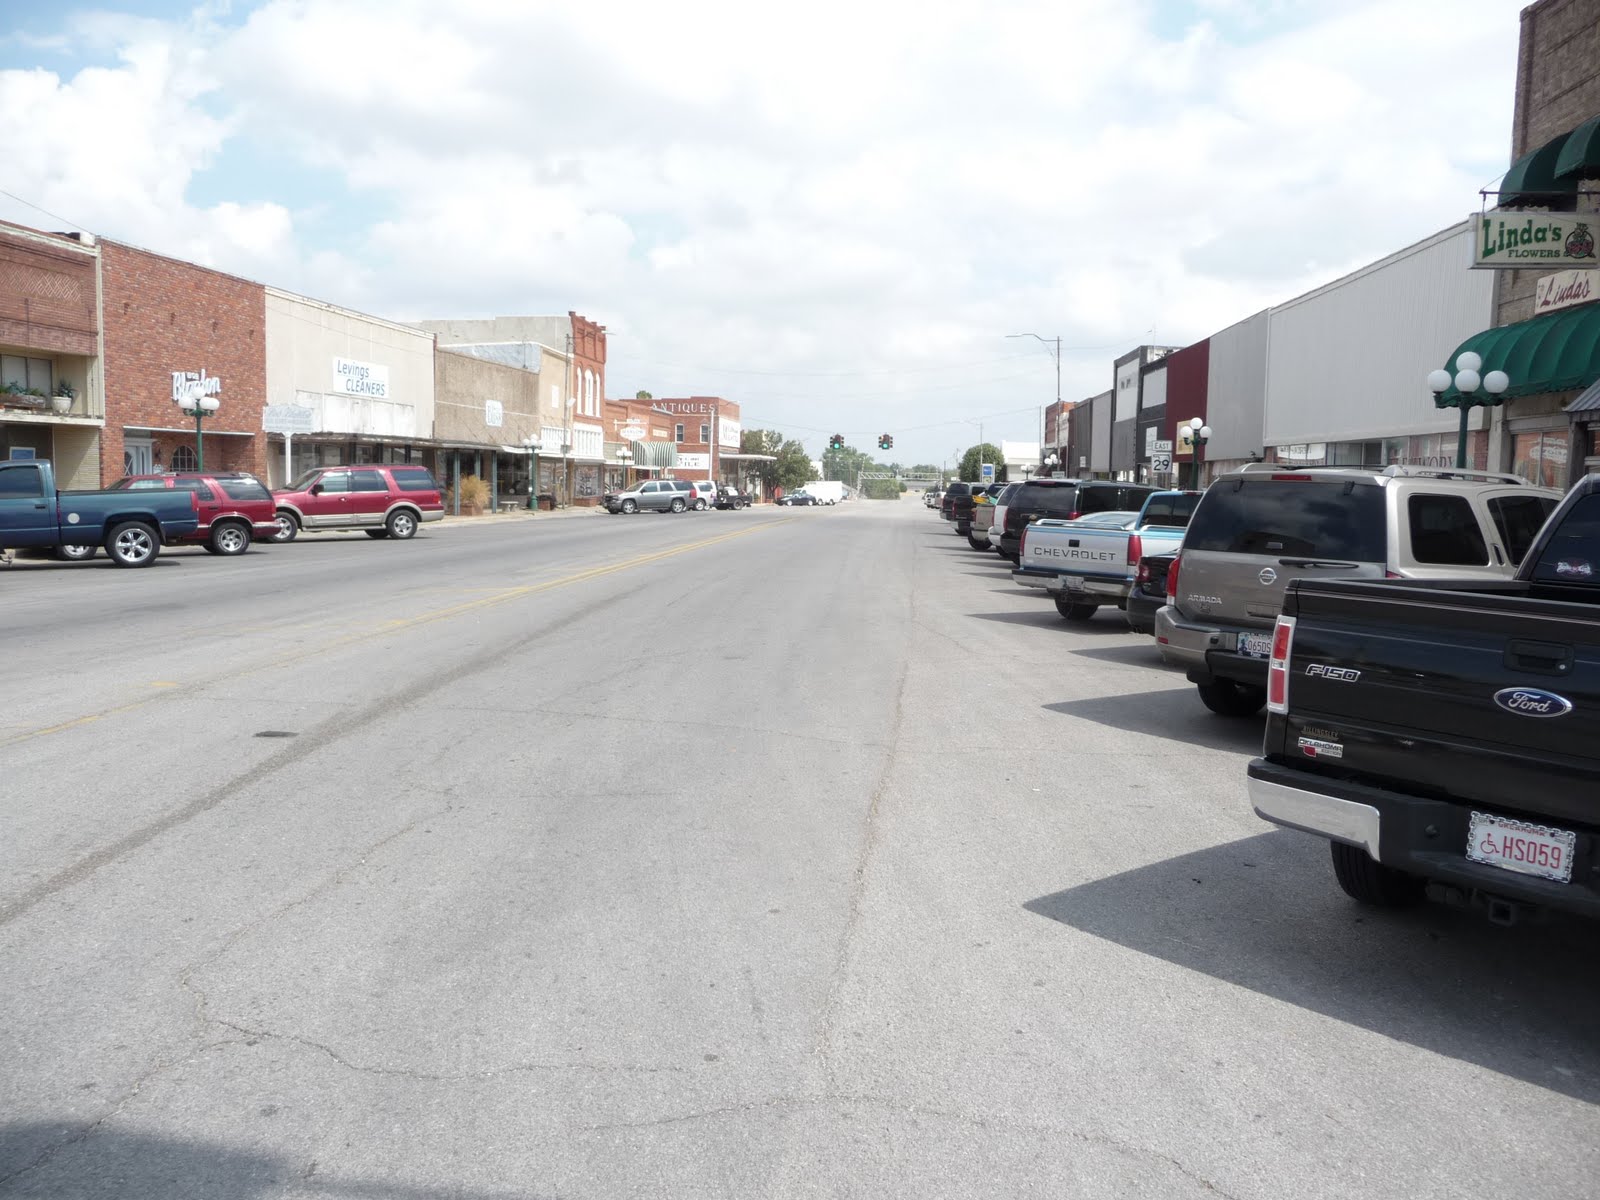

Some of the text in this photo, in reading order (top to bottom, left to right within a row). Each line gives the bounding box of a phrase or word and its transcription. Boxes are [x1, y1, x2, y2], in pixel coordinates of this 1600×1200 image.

[1482, 219, 1562, 259] Linda's
[1508, 249, 1561, 258] FLOWERS
[1540, 271, 1590, 308] Linda's
[337, 359, 370, 381] Levings
[345, 378, 385, 396] CLEANERS
[652, 402, 716, 413] ANTIQUES
[1153, 459, 1170, 471] 29
[1034, 547, 1116, 561] CHEVROLET
[1188, 594, 1222, 604] ARMADA
[1305, 663, 1361, 682] F-150
[1508, 691, 1551, 713] Ford
[1502, 835, 1562, 870] HS059
